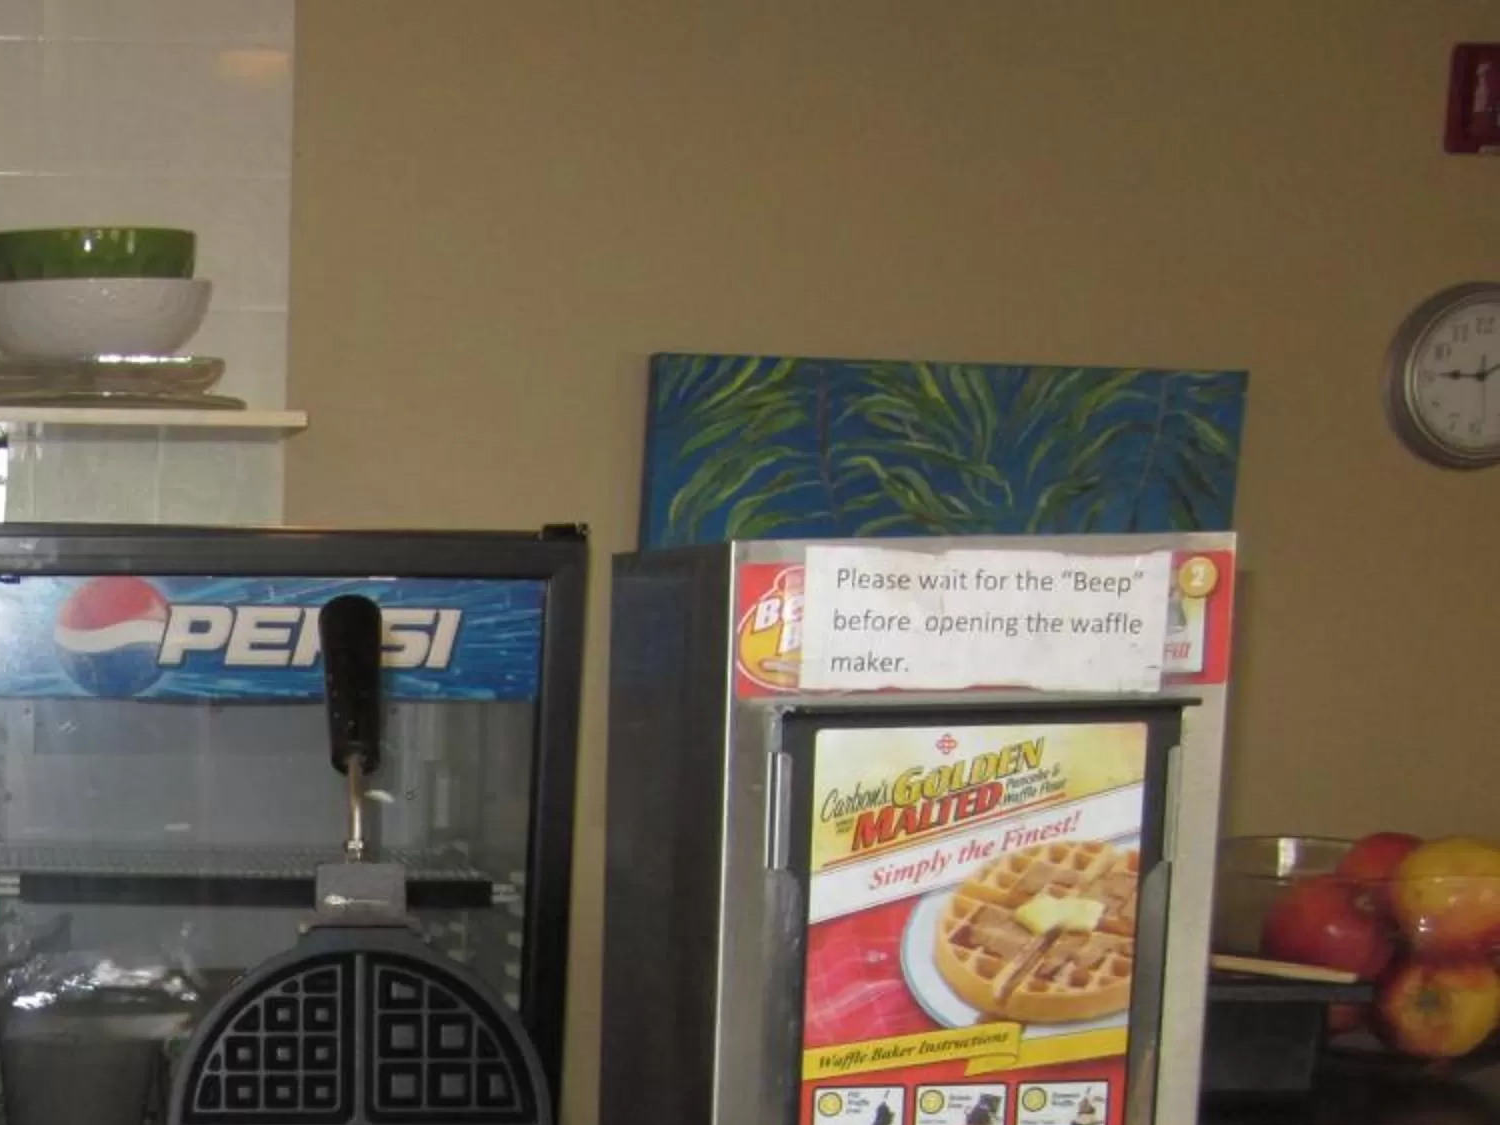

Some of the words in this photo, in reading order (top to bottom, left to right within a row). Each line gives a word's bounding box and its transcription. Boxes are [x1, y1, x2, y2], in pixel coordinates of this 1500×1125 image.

[837, 567, 911, 590] Please
[919, 571, 969, 590] wait
[975, 569, 1008, 591] for
[1015, 570, 1054, 592] the
[833, 608, 911, 632] before
[925, 611, 1018, 637] opening
[1026, 611, 1064, 633] the
[1070, 612, 1144, 635] waffle
[830, 651, 910, 673] maker.
[891, 736, 1045, 808] GOLDEN
[851, 781, 1004, 851] MALTED
[870, 850, 951, 890] Simply
[956, 838, 993, 865] the
[1001, 810, 1082, 851] Finest!
[871, 1045, 916, 1062] Baker
[918, 1031, 1010, 1056] Instructions
